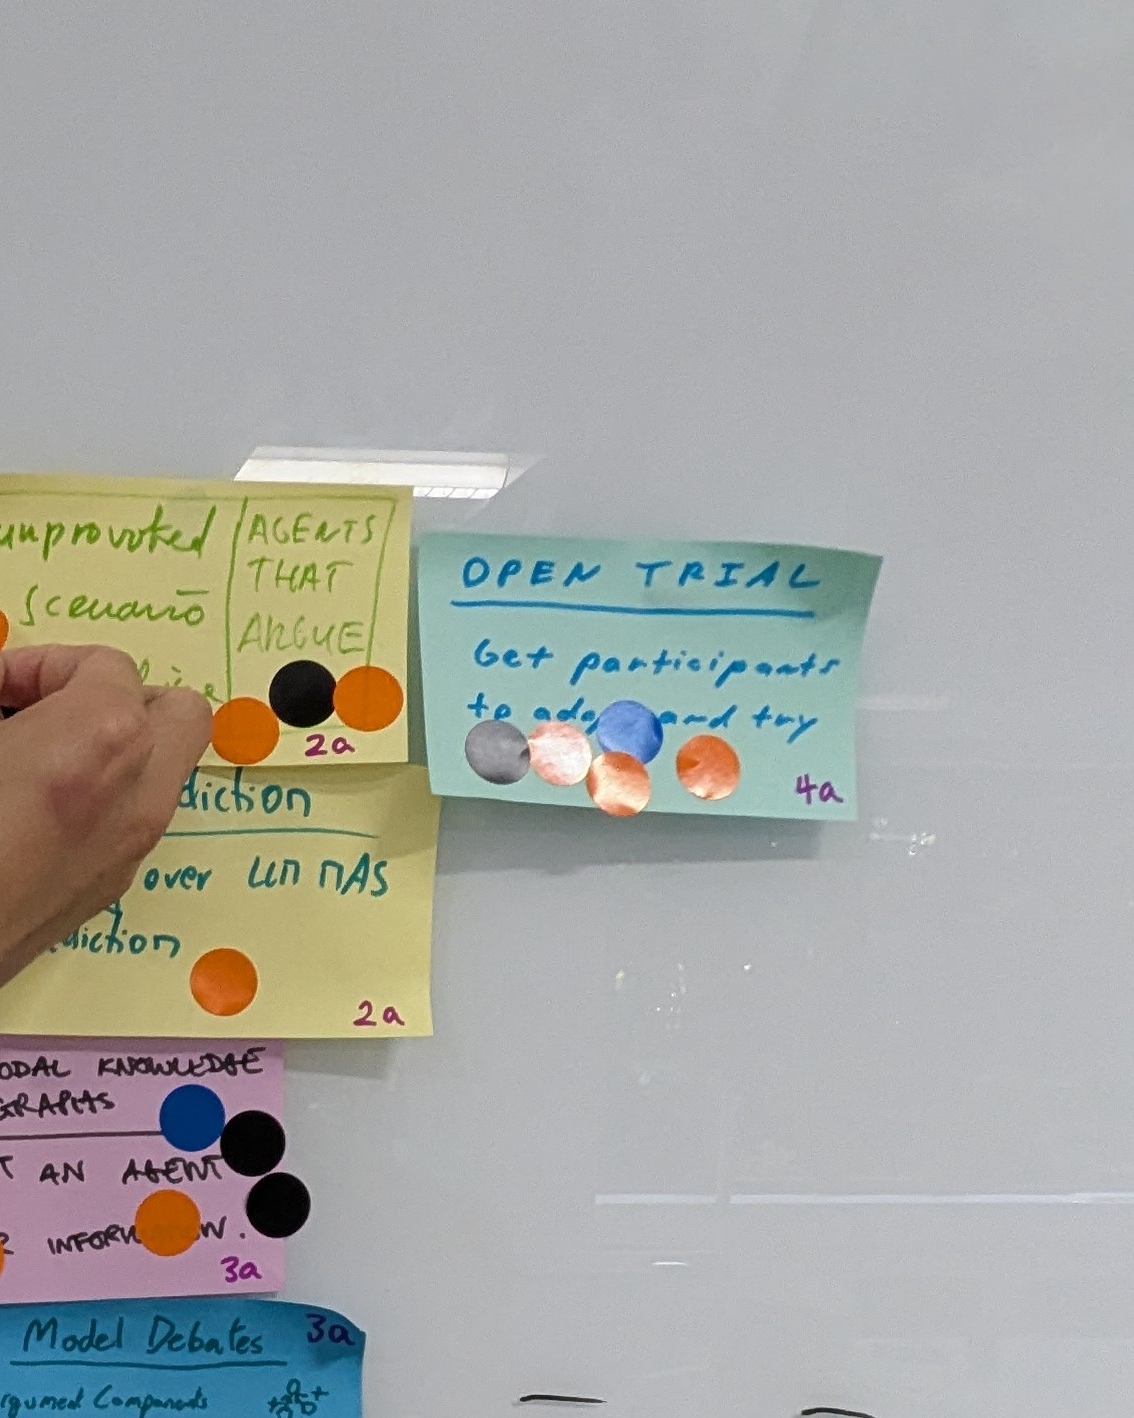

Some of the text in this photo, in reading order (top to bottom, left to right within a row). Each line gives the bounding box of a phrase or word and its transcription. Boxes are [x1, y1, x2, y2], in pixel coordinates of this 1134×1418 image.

[248, 513, 374, 545] AGENTS
[247, 558, 353, 593] THAT
[462, 556, 820, 588] OPEN TRIAL
[237, 612, 364, 654] ARGUE
[474, 638, 840, 687] Get participants
[468, 692, 512, 721] to
[659, 704, 738, 729] and
[752, 705, 818, 743] try
[304, 734, 354, 757] 2a
[177, 767, 311, 817] diction
[795, 774, 844, 804] 4a
[144, 864, 212, 892] over
[353, 1000, 405, 1027] 2a
[98, 1047, 266, 1077] KNOWLEDGE
[39, 1161, 86, 1184] AN
[122, 1156, 224, 1184] AGENT
[220, 1256, 262, 1283] 3a
[23, 1317, 264, 1356] Model Debates
[306, 1314, 355, 1346] 3a
